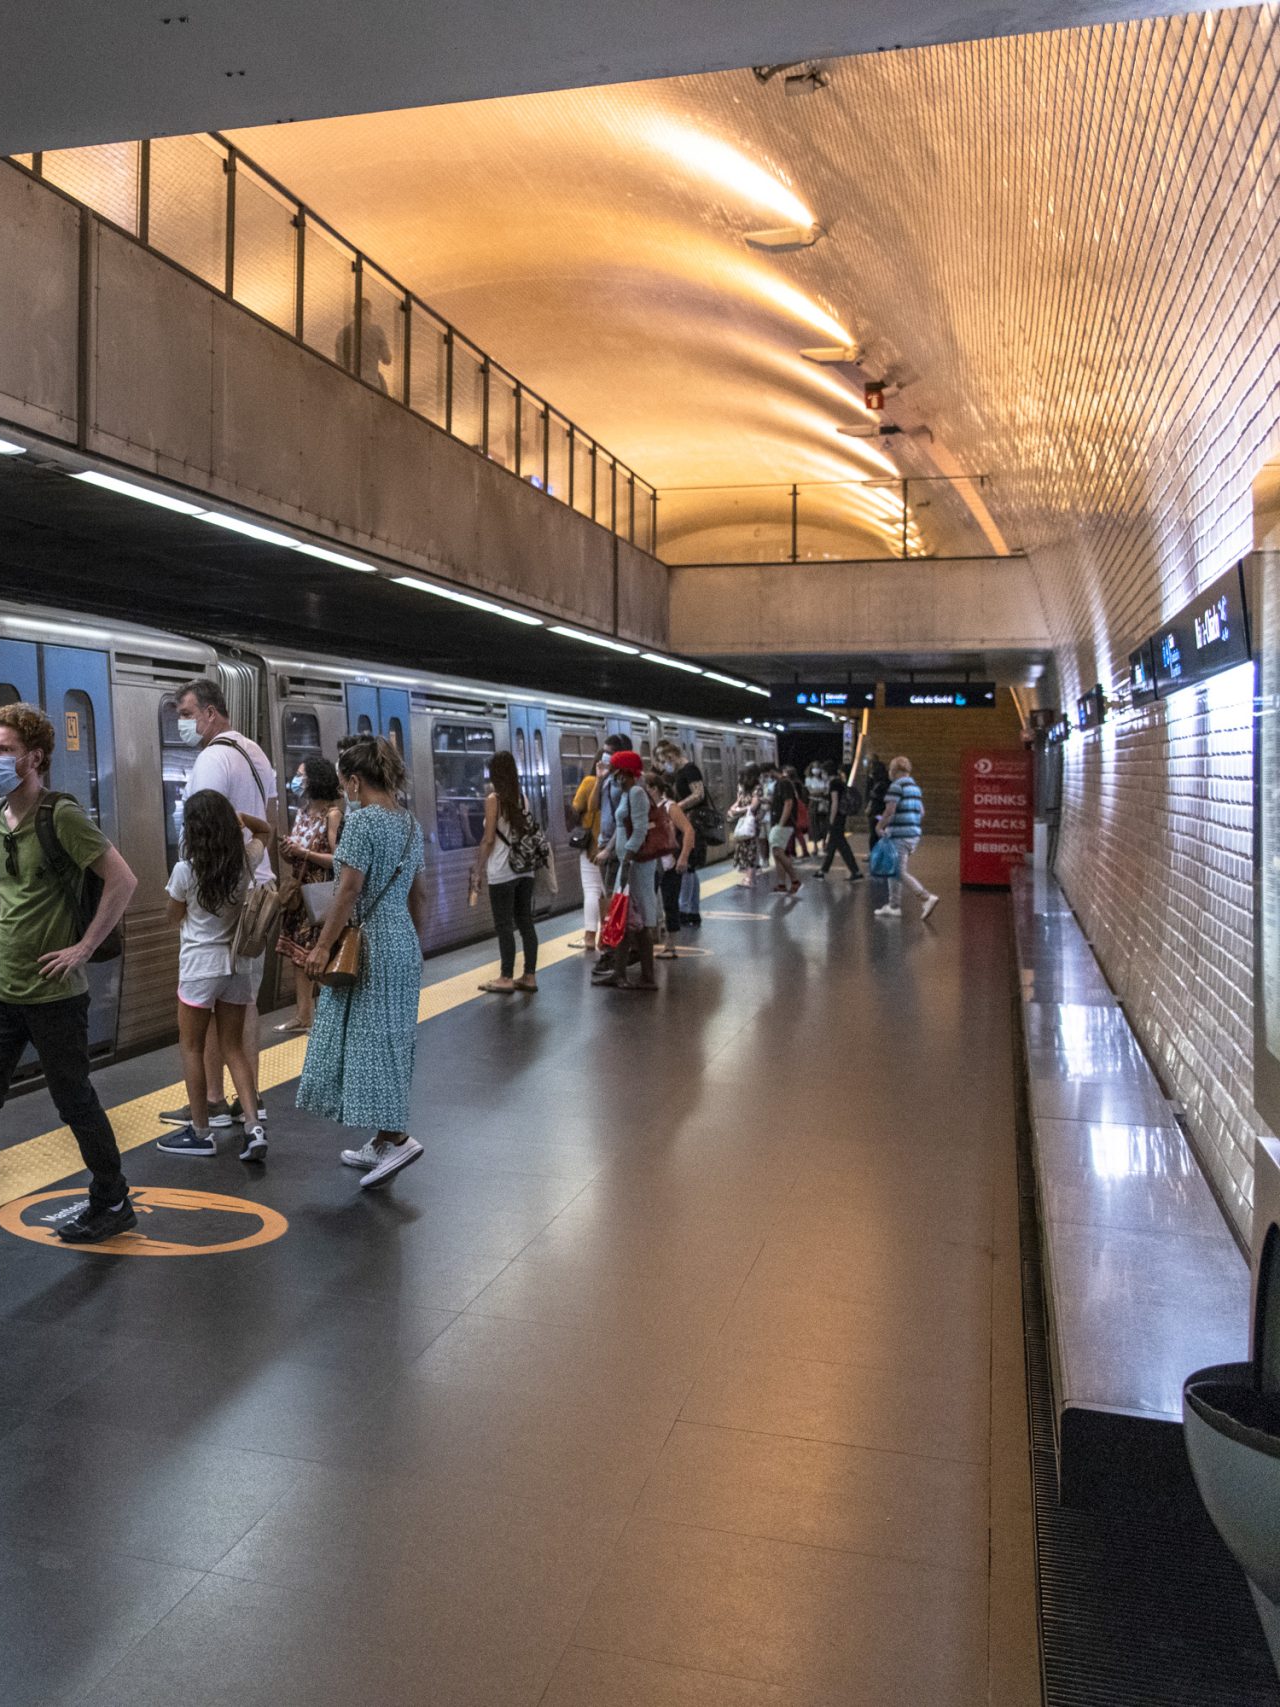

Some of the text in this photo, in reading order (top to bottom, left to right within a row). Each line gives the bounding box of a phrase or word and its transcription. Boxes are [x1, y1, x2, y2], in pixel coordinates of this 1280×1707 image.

[974, 794, 1027, 806] DRINKS
[974, 818, 1027, 829] SNACKS
[974, 843, 1027, 855] BEBIDAS
